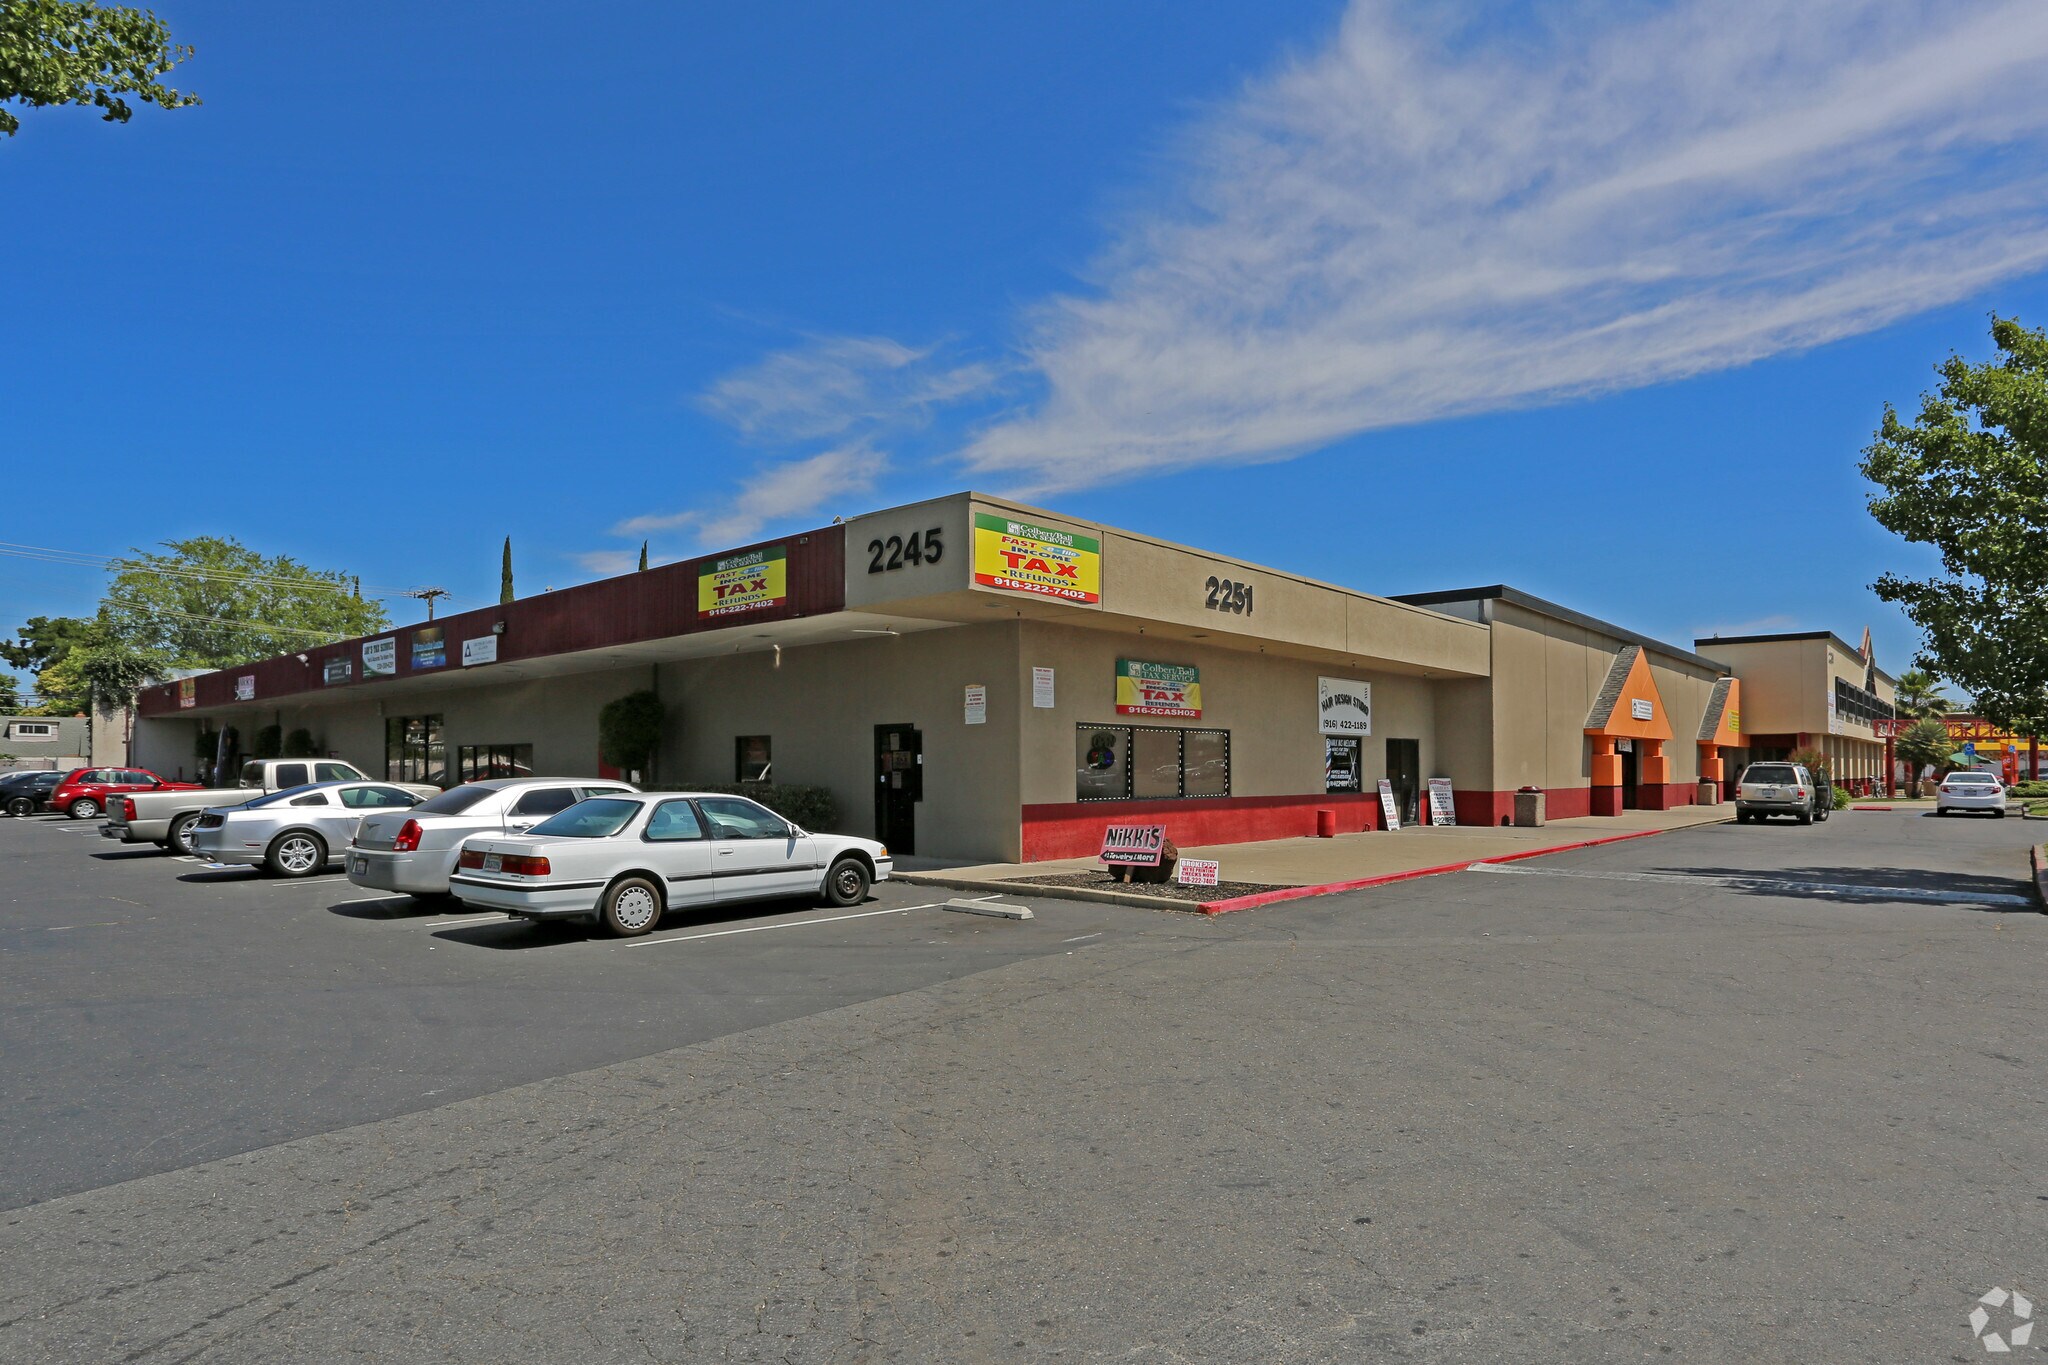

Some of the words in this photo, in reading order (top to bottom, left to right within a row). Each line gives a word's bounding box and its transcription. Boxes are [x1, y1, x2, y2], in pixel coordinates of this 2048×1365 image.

[1020, 525, 1073, 541] Colbert/Ball
[1020, 531, 1038, 539] TAX
[1040, 534, 1074, 547] SERVICE
[1002, 536, 1037, 548] FAST
[868, 527, 943, 574] 2245
[1011, 546, 1072, 562] INCOME
[1000, 550, 1078, 579] TAX
[714, 571, 737, 580] FAST
[720, 573, 762, 585] INCOME
[1010, 570, 1069, 586] REFUNDS
[713, 578, 767, 599] TAX
[994, 577, 1086, 599] 916-222-7402
[719, 594, 760, 606] REFUNDS
[1205, 575, 1253, 617] 2251
[709, 600, 774, 616] 916-222-7402
[1142, 663, 1195, 676] Colbert/Ball
[1162, 673, 1195, 682] SERVICE
[1139, 689, 1185, 702] TAX
[1128, 707, 1196, 717] 916-2CASH02
[1321, 696, 1334, 713] HAIR
[1334, 693, 1352, 706] DESIGN
[1353, 697, 1369, 717] STUDIO
[1323, 719, 1338, 729] (916)
[1137, 853, 1155, 861] More
[1181, 861, 1217, 869] BROKE???
